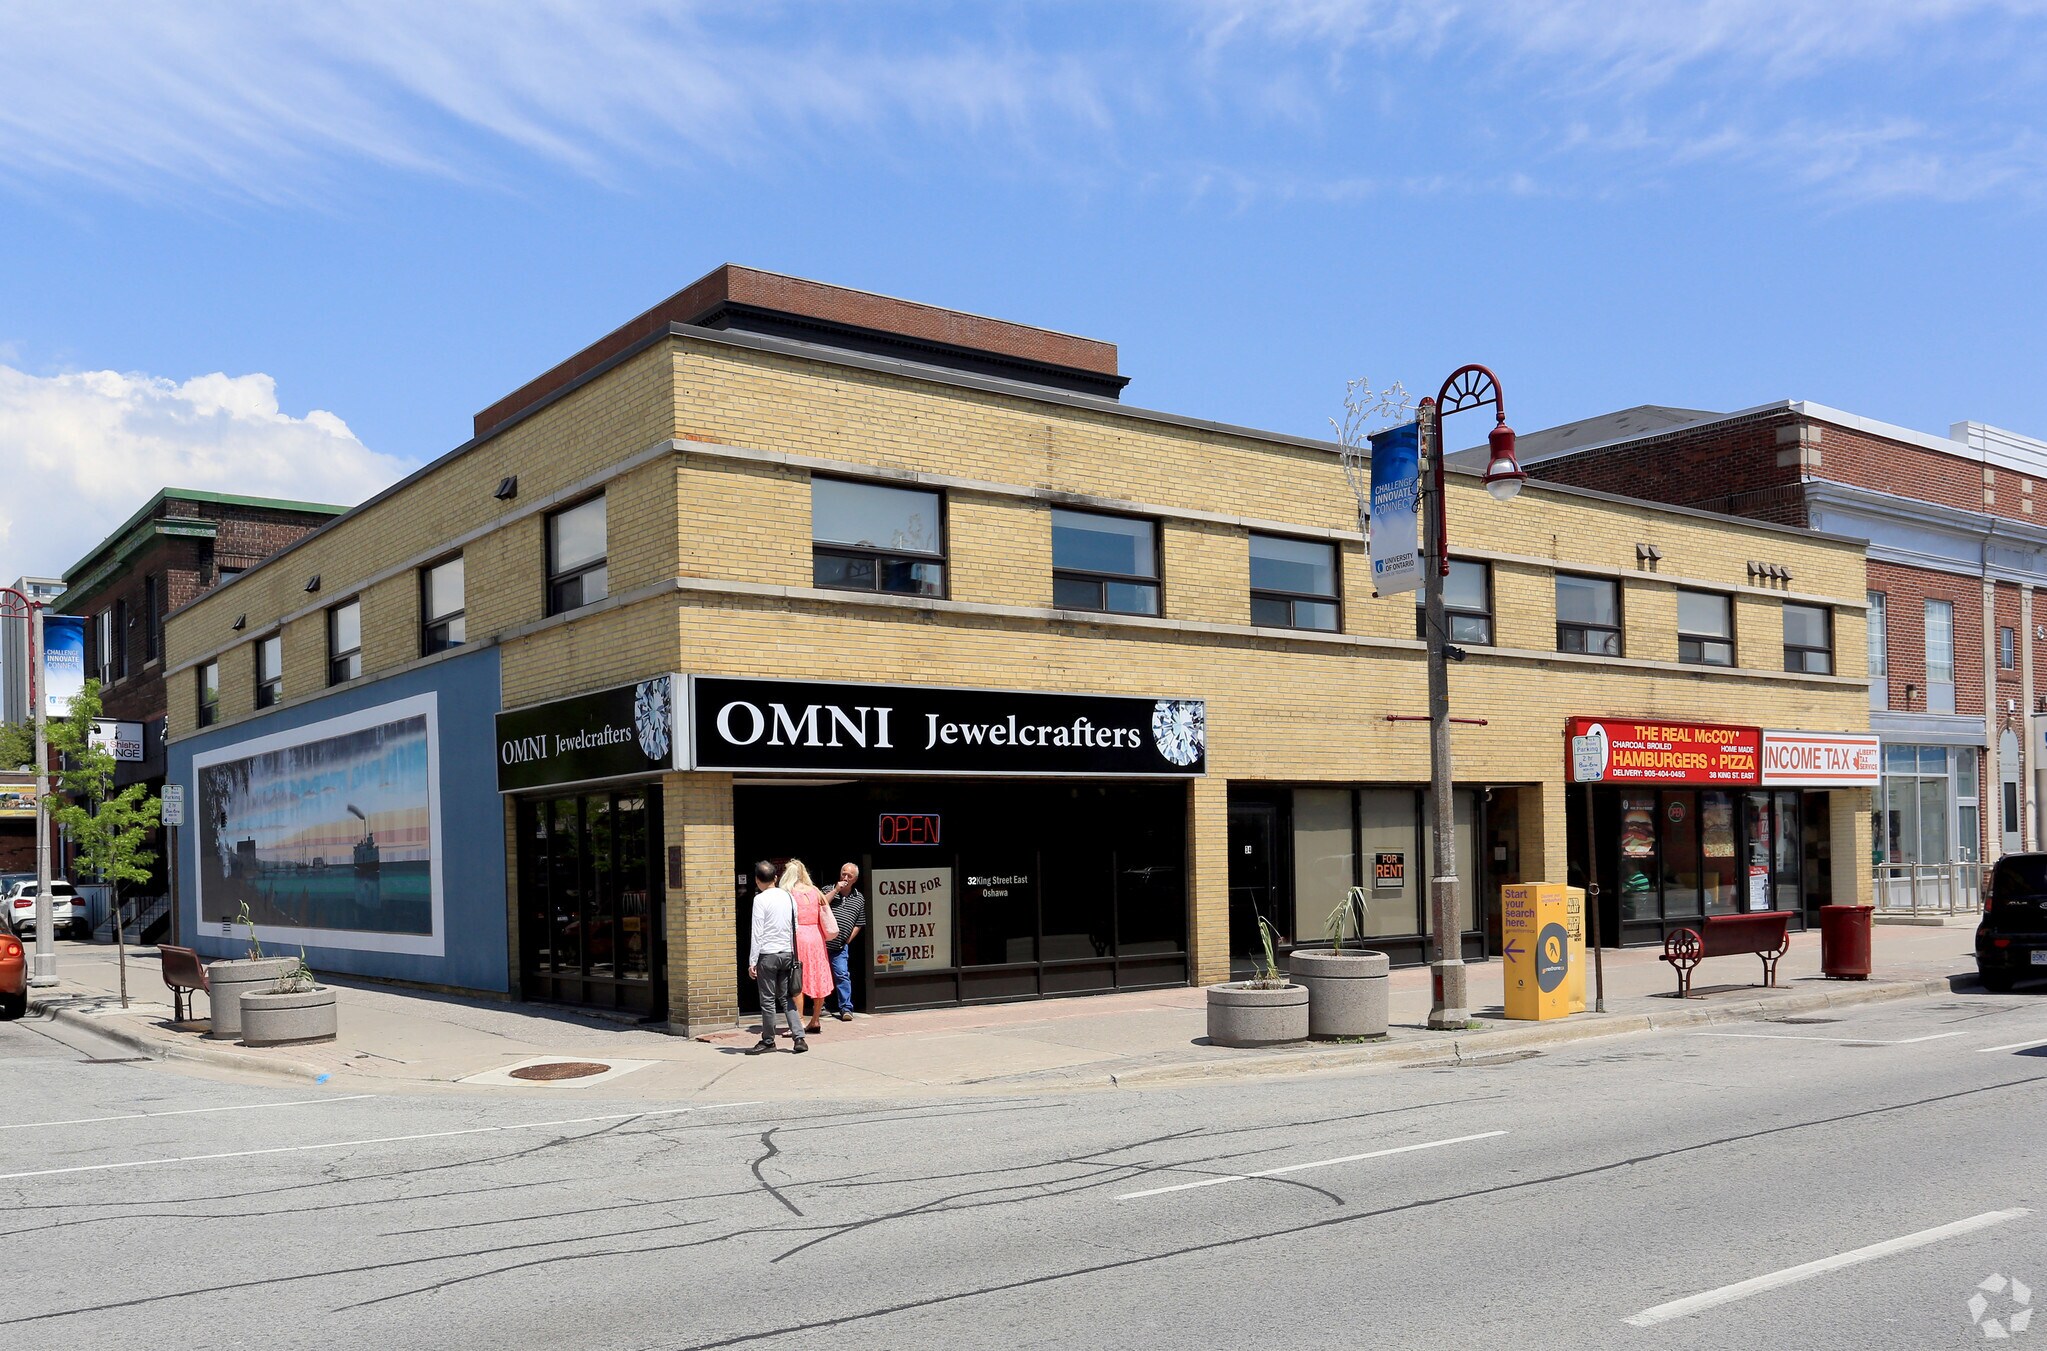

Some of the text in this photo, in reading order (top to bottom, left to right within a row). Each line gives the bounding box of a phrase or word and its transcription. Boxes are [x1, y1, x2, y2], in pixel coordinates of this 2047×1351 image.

[1375, 477, 1413, 495] CHALLENGE
[1375, 490, 1413, 506] INNOVATE
[1375, 498, 1414, 516] CONNECT
[1384, 552, 1414, 564] UNIVERSITY
[1393, 560, 1414, 570] ONTARIO
[716, 700, 1141, 750] OMNI Jewelcrafters
[1634, 726, 1658, 740] THE
[1662, 727, 1692, 742] REAL
[502, 724, 632, 765] OMNI Jewelcrafters
[1612, 741, 1645, 749] CHARCOAL
[98, 748, 140, 758] OUNGE
[1764, 746, 1850, 770] INCOME TAX
[1612, 750, 1754, 770] HAMBURGERS PIZZA
[1613, 769, 1643, 777] DELIVERY:
[881, 816, 938, 843] OPEN
[1382, 855, 1397, 863] FOR
[1376, 864, 1404, 877] RENT
[879, 876, 942, 895] CASH FOR
[992, 876, 1012, 884] Street
[1014, 875, 1028, 884] East
[982, 889, 1008, 898] Oshawa
[1505, 889, 1527, 898] Start
[888, 902, 932, 917] GOLD!
[1506, 899, 1524, 909] your
[1505, 909, 1535, 918] search
[1506, 918, 1528, 927] here.
[886, 923, 935, 939] WE PAY
